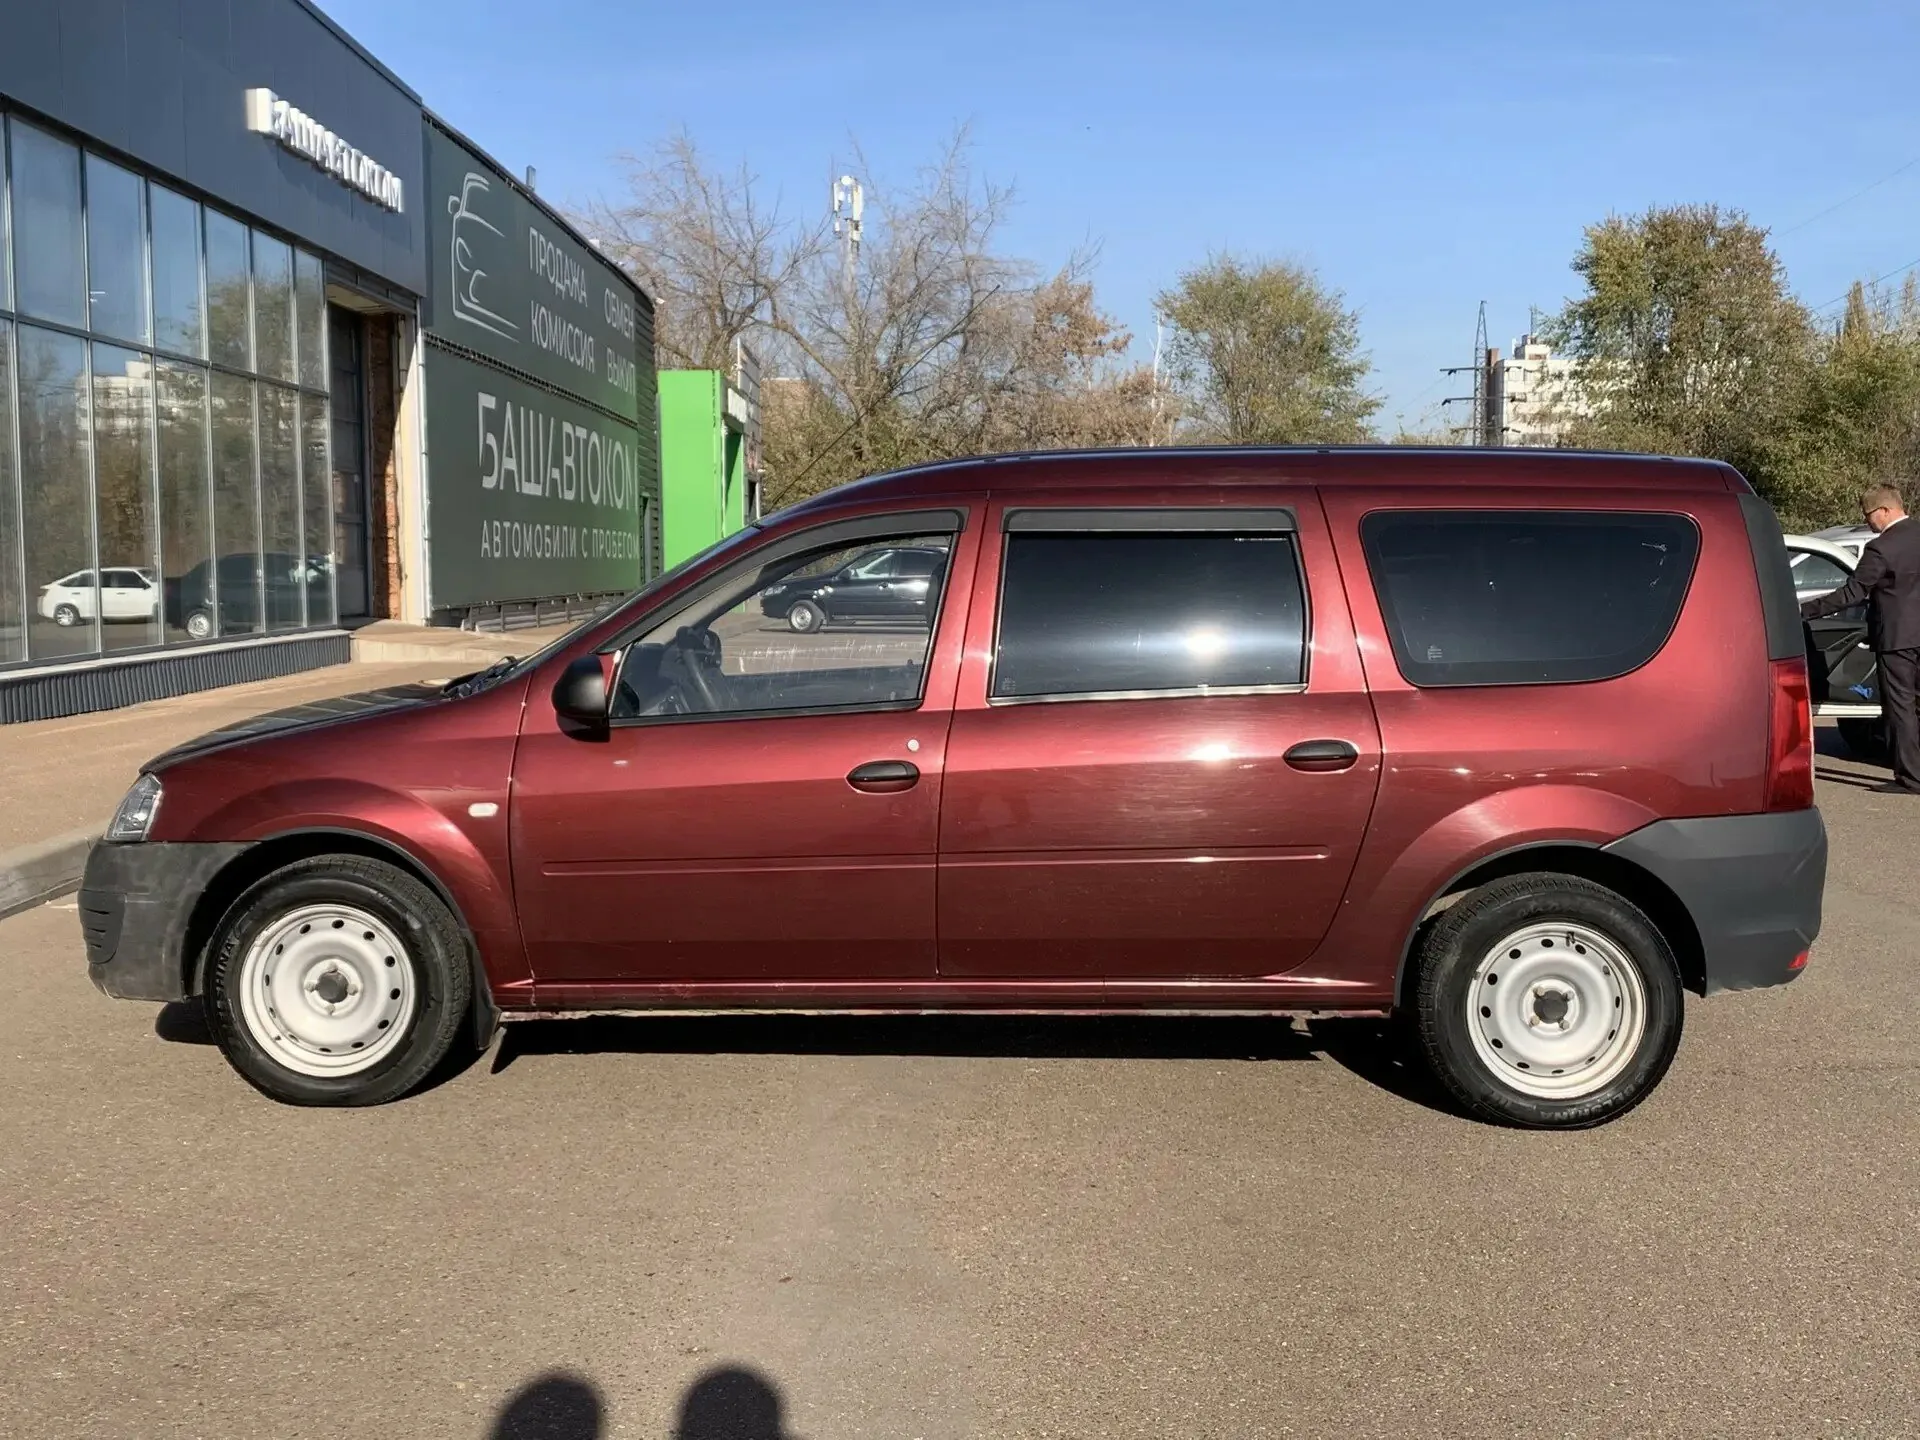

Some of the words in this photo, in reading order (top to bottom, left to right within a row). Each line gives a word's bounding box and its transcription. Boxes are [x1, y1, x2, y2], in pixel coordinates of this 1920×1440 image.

[528, 226, 588, 308] ПРОДАЖА
[530, 300, 595, 374] КОМИССИЯ
[604, 287, 635, 342] ОБМЕН
[607, 347, 636, 397] ВЫКУП
[477, 391, 638, 515] БАШАВТОКОМ
[481, 519, 577, 558] АВТОМОБИЛИ
[582, 526, 590, 558] С
[592, 528, 639, 559] ПРОБЕГОМ
